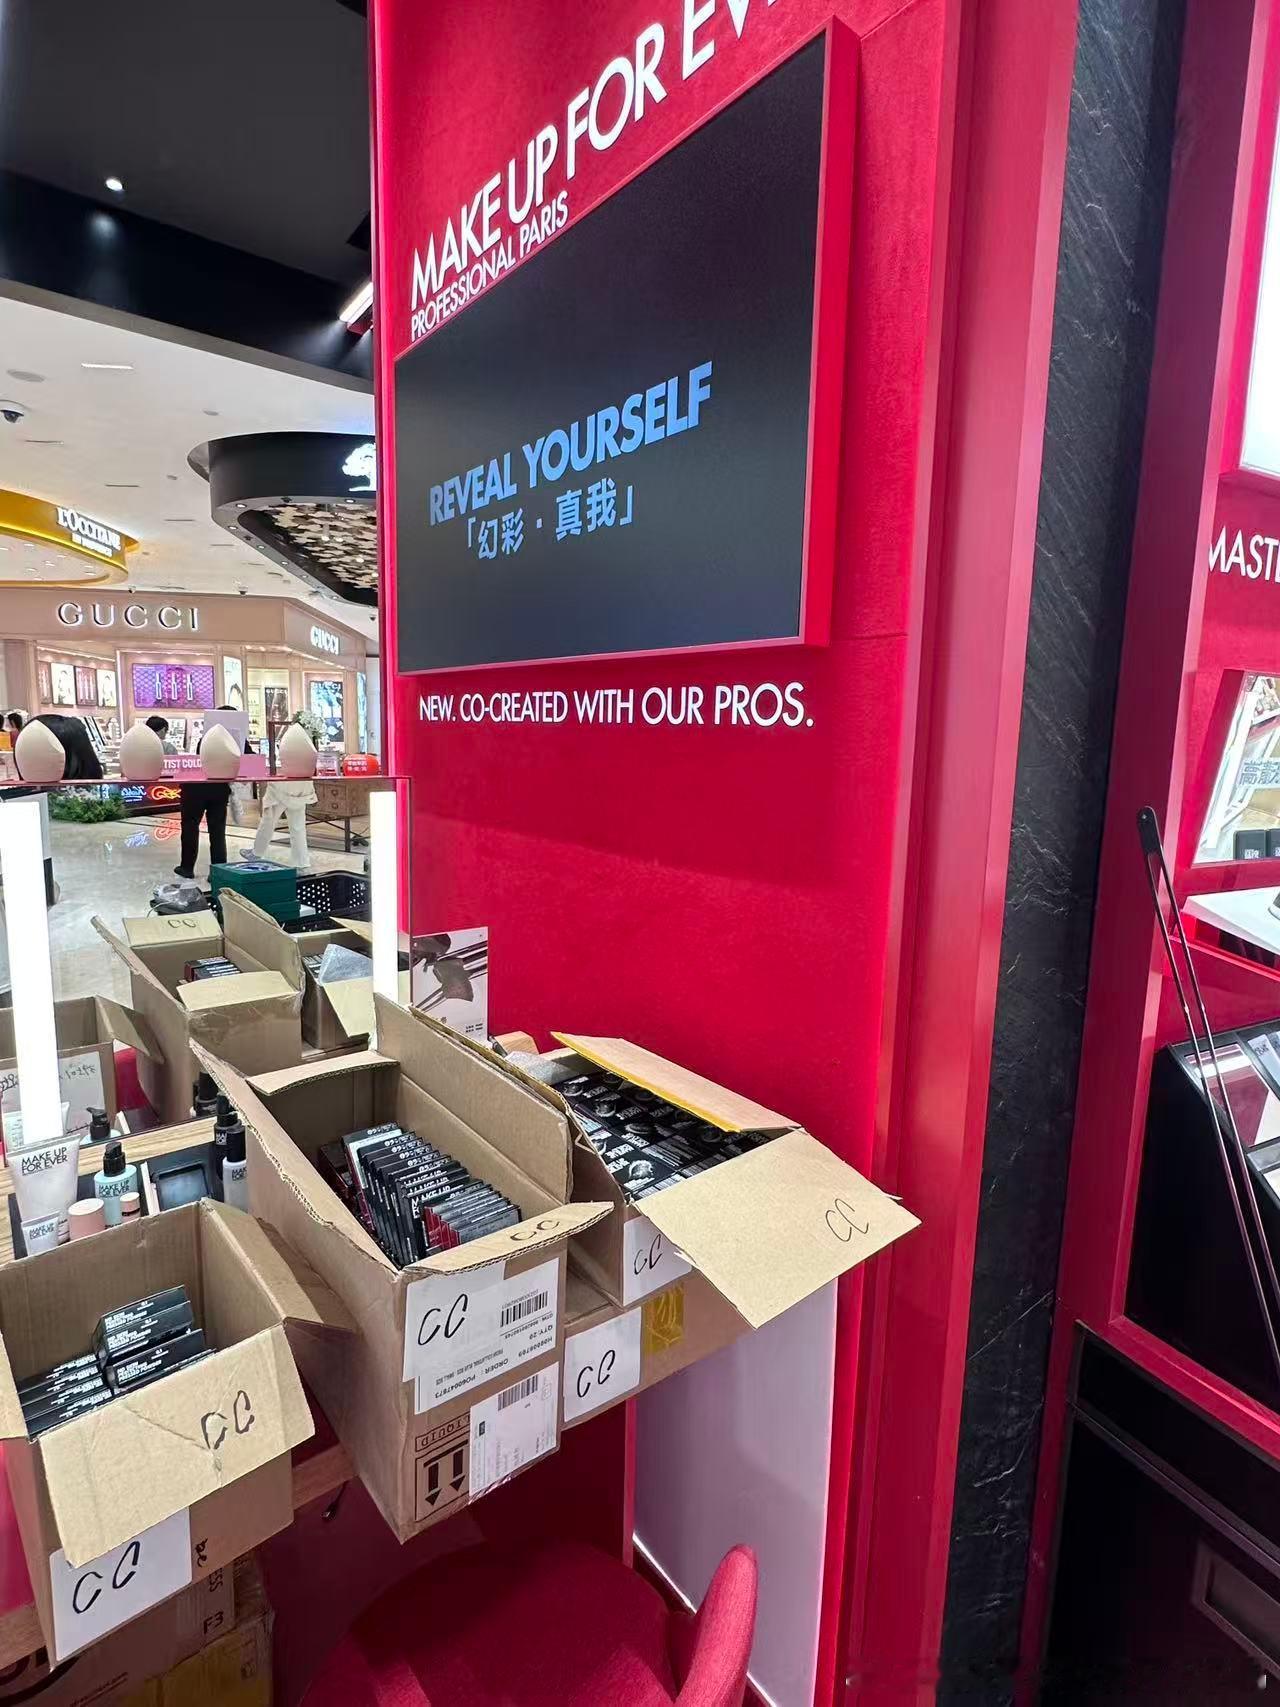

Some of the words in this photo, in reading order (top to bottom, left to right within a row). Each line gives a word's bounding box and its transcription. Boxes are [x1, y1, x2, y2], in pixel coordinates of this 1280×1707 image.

[410, 173, 501, 311] MAKE
[508, 124, 558, 224] UP
[567, 22, 667, 180] FOR
[410, 246, 516, 341] PROFESSIONAL
[519, 190, 568, 259] PARIS
[430, 452, 518, 526] REVEAL
[522, 361, 713, 488] YOURSELF
[57, 602, 199, 631] GUCCI
[419, 695, 456, 722] NEW.
[460, 691, 568, 723] CO-CREATED
[573, 688, 632, 725] WITH
[641, 686, 704, 726] OUR
[715, 681, 814, 728] PROS.
[22, 1151, 51, 1166] MAKE
[54, 1146, 67, 1157] UP
[22, 1161, 42, 1174] FOR
[44, 1154, 67, 1168] EVER
[825, 1198, 870, 1243] CC
[417, 1293, 469, 1346] CC
[577, 1349, 616, 1398] CC
[201, 1390, 255, 1450] CC
[421, 1413, 470, 1446] LIQUID
[72, 1541, 140, 1615] CC
